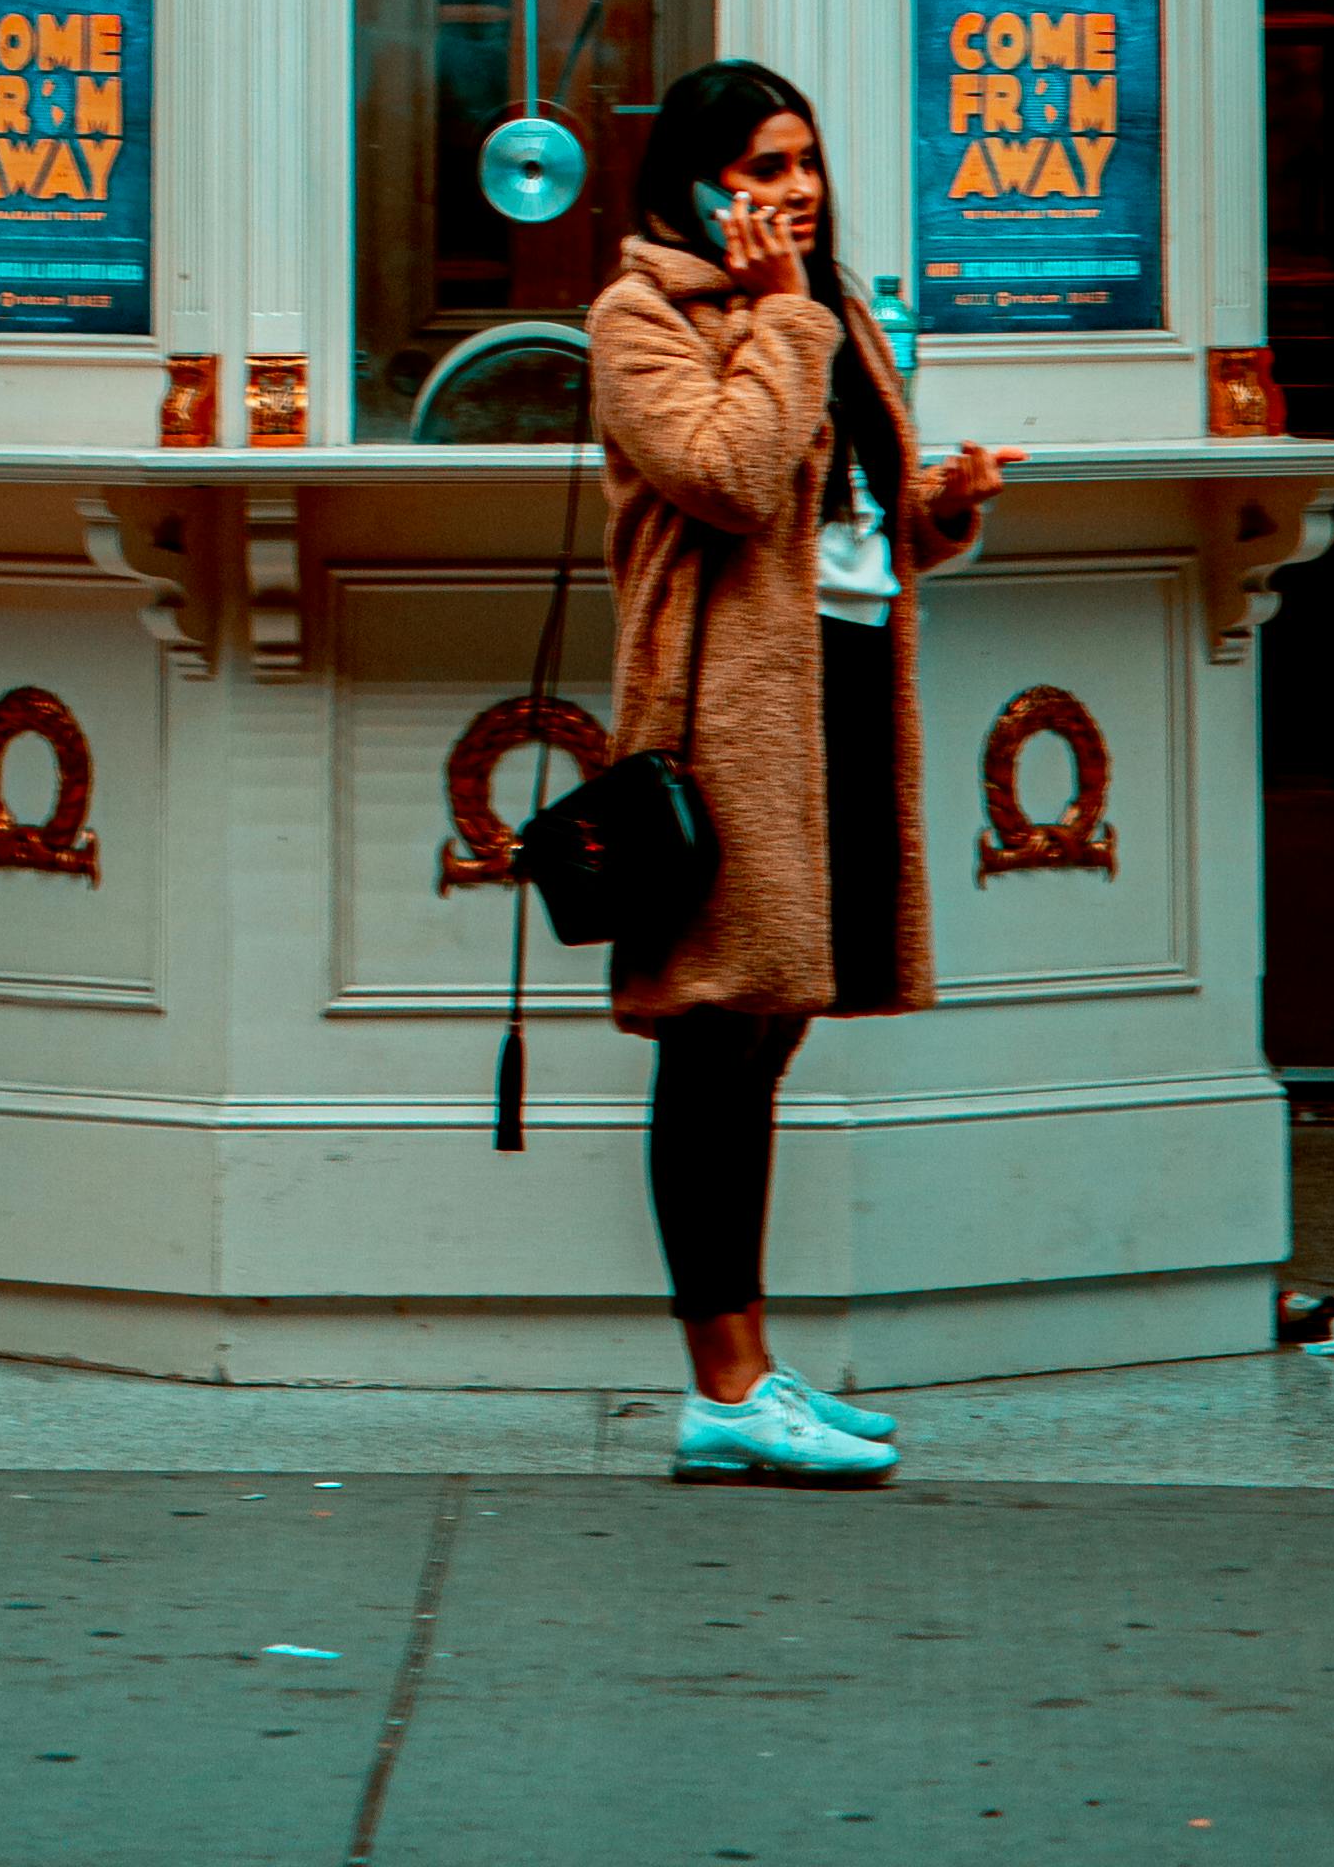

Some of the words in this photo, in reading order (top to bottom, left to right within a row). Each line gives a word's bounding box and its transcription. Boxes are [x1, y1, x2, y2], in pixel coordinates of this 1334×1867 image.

[949, 11, 1116, 70] COME
[949, 73, 1118, 134] FROM
[948, 136, 1117, 198] AWAY
